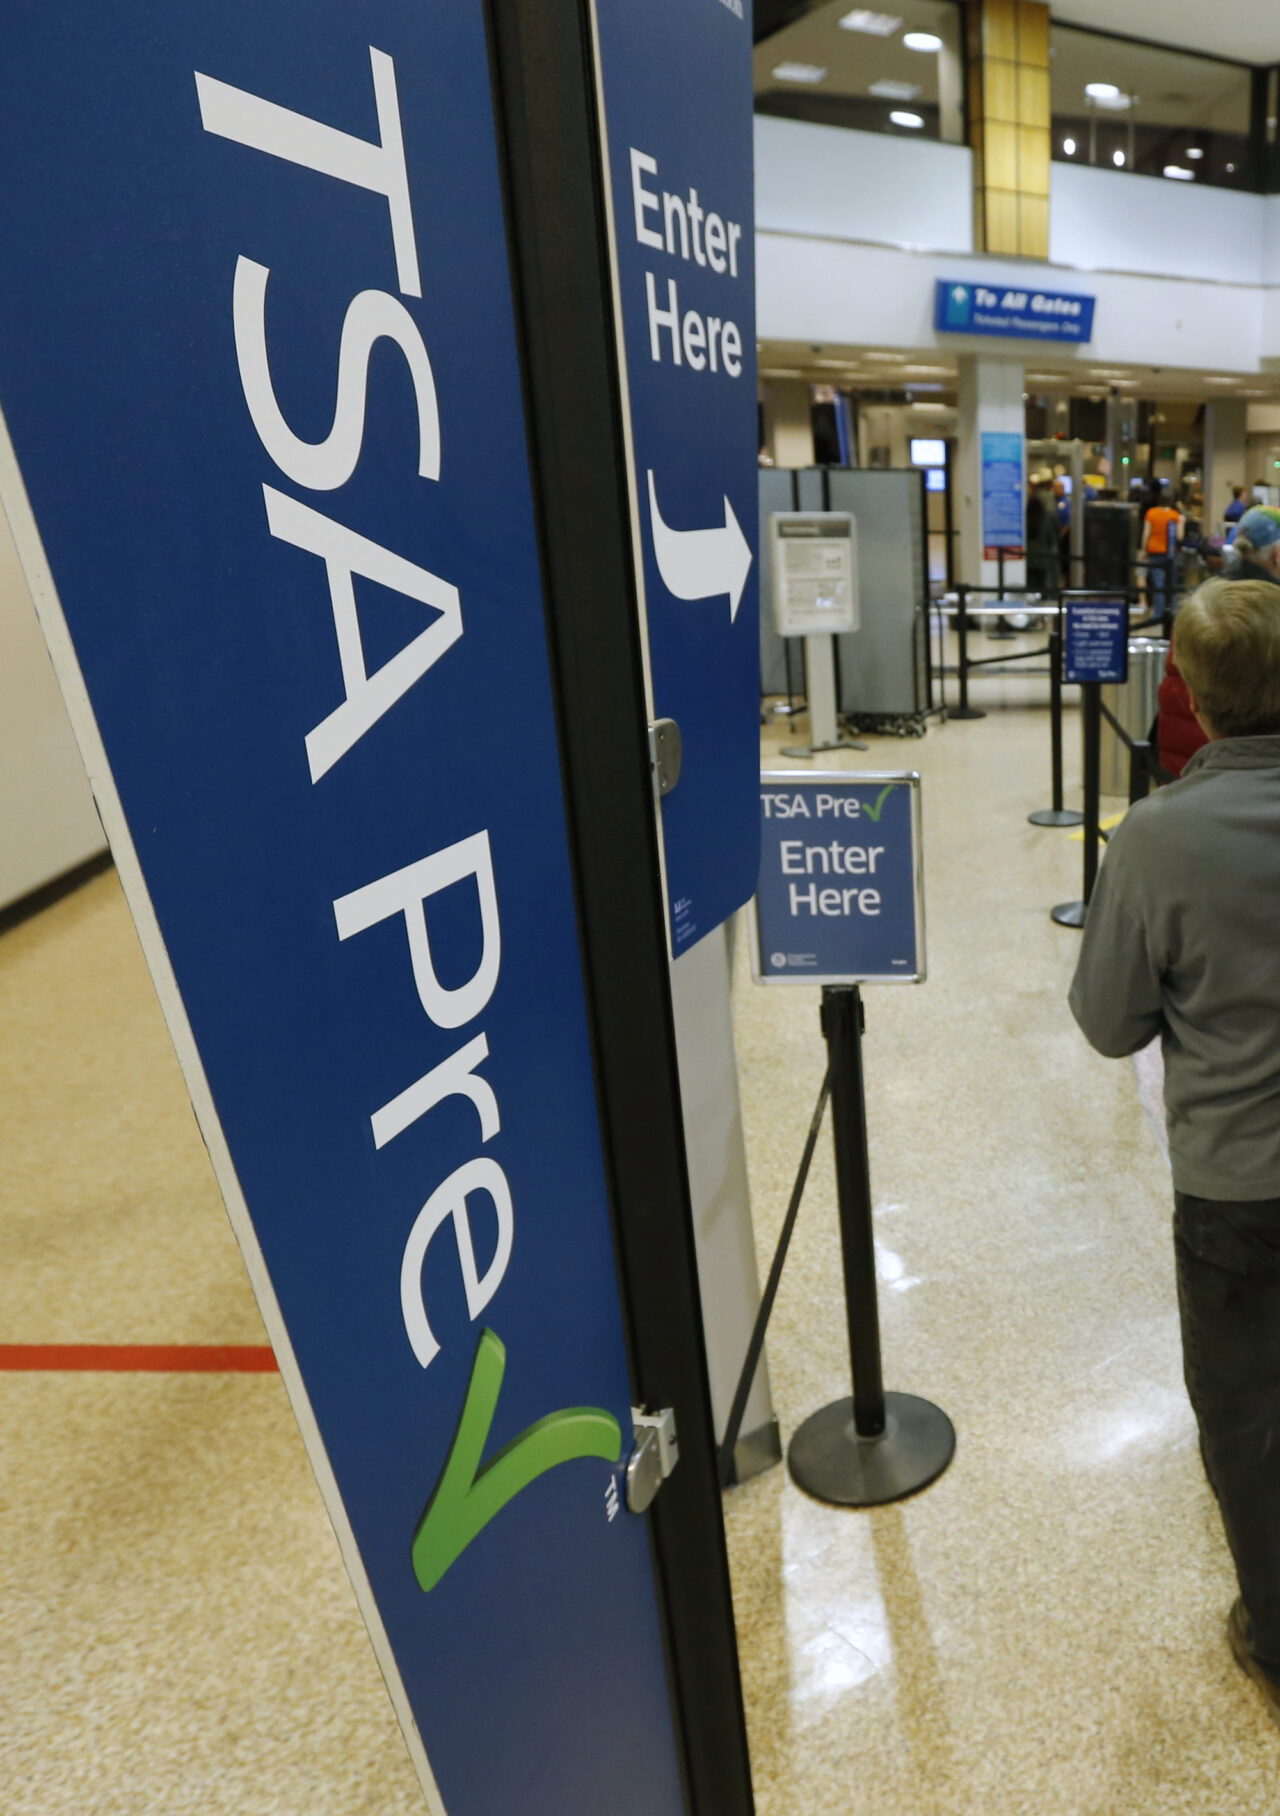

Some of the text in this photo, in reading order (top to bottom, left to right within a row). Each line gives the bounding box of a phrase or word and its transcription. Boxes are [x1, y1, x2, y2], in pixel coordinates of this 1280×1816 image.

[629, 147, 742, 279] Enter
[974, 288, 1082, 317] To All Gates
[645, 271, 743, 378] Here
[195, 46, 463, 784] TSA
[333, 829, 514, 1369] Pre
[761, 793, 861, 819] TSA Pre
[780, 840, 885, 875] Enter
[788, 882, 881, 917] Here
